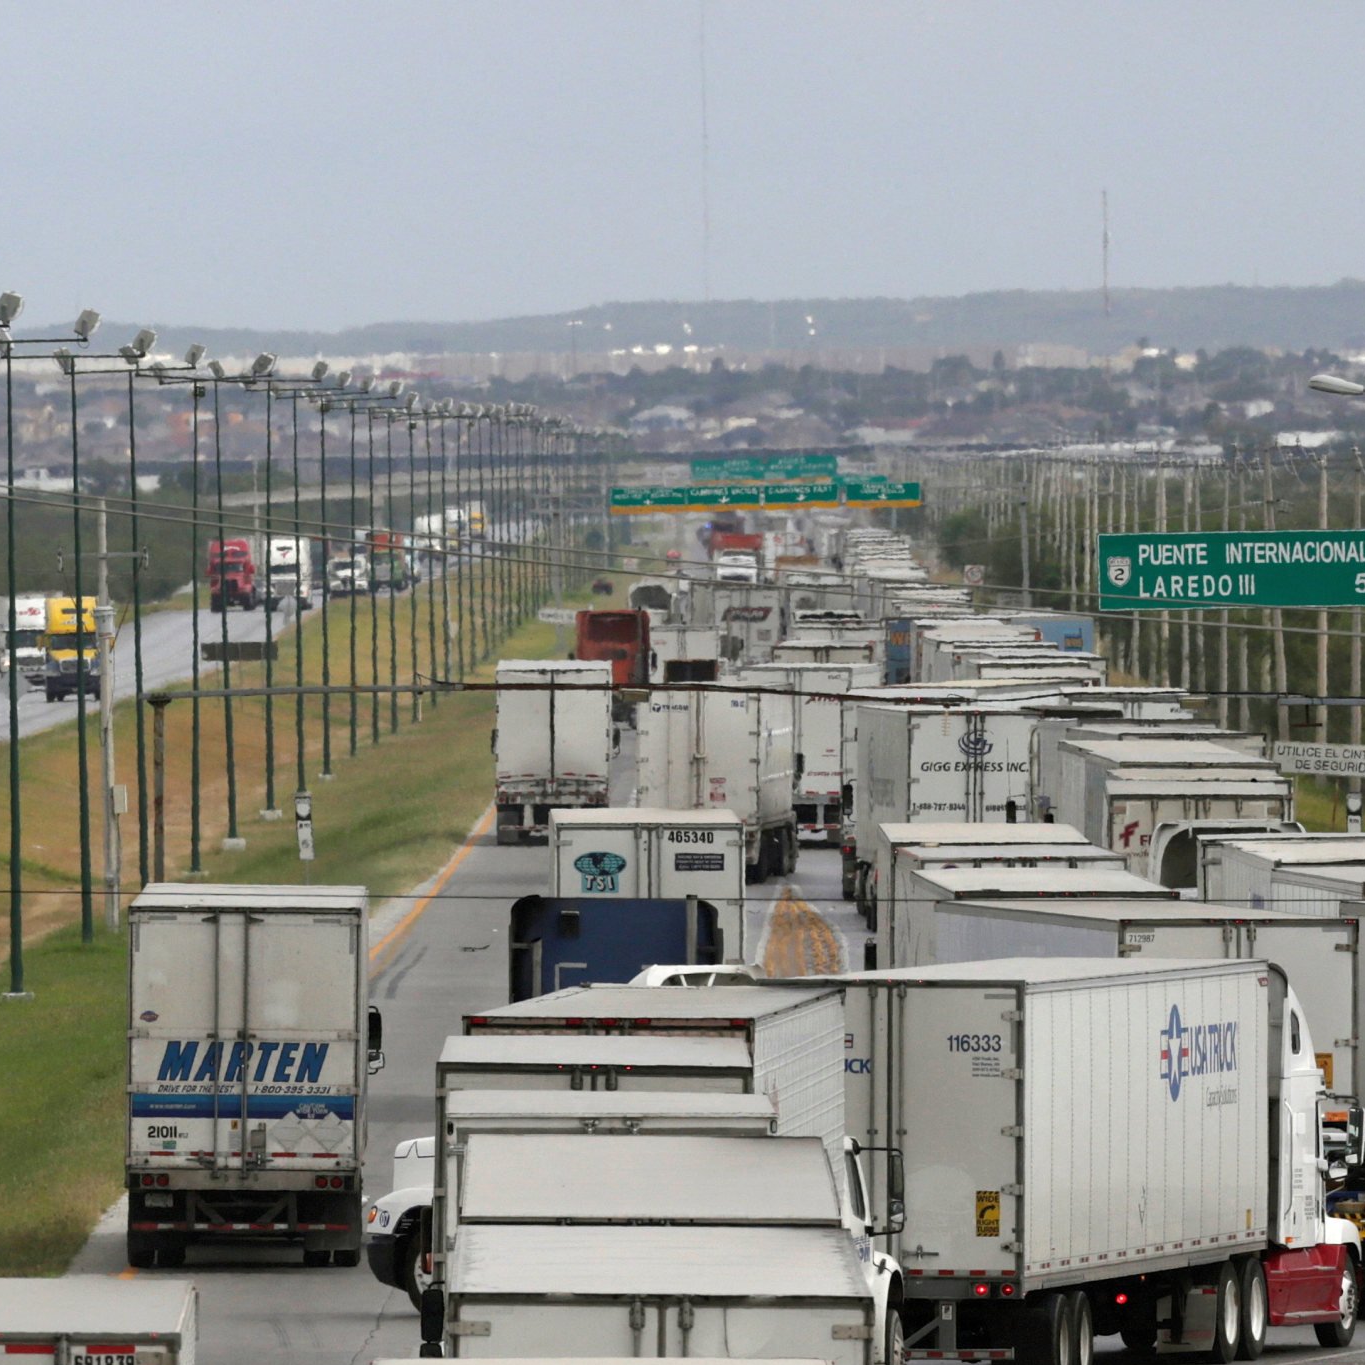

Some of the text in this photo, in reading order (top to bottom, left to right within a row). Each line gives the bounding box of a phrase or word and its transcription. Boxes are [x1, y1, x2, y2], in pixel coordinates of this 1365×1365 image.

[1138, 543, 1208, 566] PUENTE
[1114, 567, 1125, 582] 2
[1138, 575, 1233, 598] LAREDO
[1238, 574, 1256, 596] III
[1277, 745, 1322, 759] UTILICE
[1324, 747, 1339, 760] EL
[920, 761, 1030, 773] GIGG EXPRESS INC.
[1295, 758, 1310, 771] DE
[585, 875, 616, 892] TSI
[1128, 933, 1155, 944] 712987
[946, 1034, 1002, 1053] 116333
[157, 1040, 330, 1083] MARTEN
[157, 1084, 181, 1094] DRIVE
[181, 1084, 198, 1093] FOR
[198, 1084, 214, 1093] THE
[147, 1125, 178, 1139] 21011
